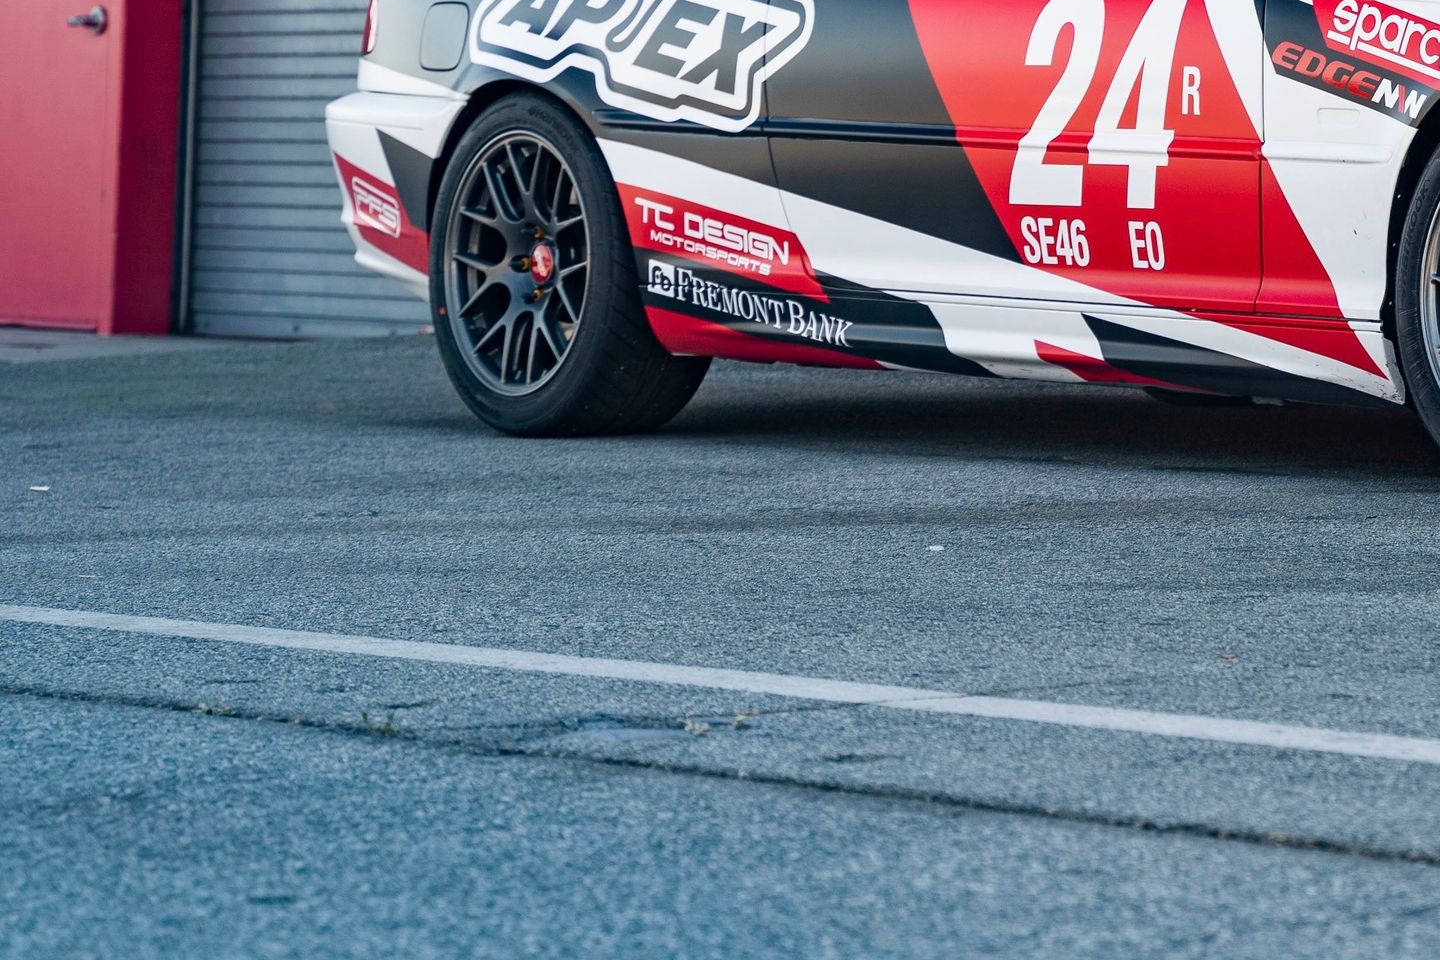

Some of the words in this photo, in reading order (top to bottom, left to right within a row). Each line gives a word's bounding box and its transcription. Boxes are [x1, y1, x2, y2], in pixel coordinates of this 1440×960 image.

[1181, 65, 1201, 116] R
[633, 196, 676, 232] TC
[683, 211, 790, 266] DESIGN
[650, 229, 772, 277] MOTORSPORTS
[1020, 215, 1091, 268] SE46
[676, 266, 785, 329] FREMONT
[785, 298, 855, 349] BANK
